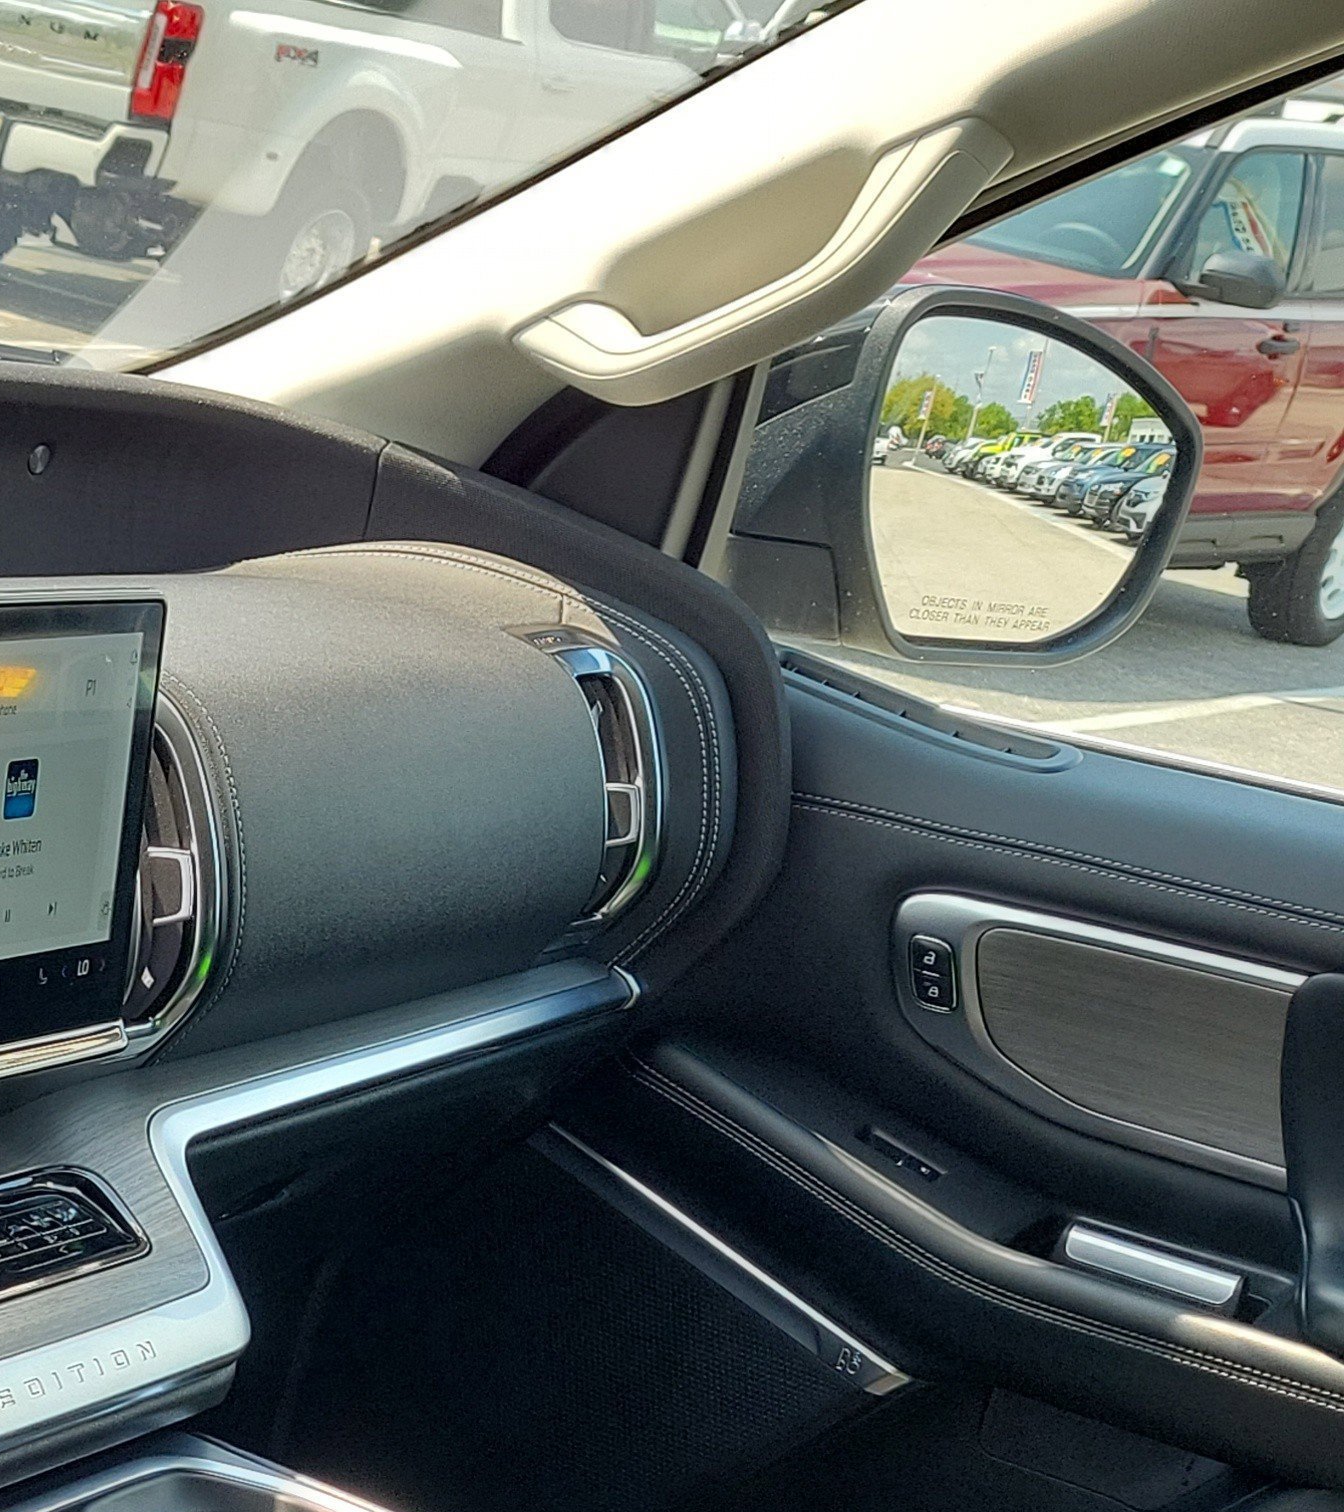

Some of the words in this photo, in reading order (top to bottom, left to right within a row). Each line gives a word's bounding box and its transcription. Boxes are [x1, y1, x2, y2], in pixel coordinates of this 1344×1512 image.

[921, 595, 967, 610] OBJECTS
[971, 601, 983, 611] IN
[987, 603, 1025, 616] MIRROR
[1027, 606, 1049, 618] ARE
[909, 608, 949, 622] CLOSER
[953, 613, 981, 626] THAN
[984, 616, 1009, 628] THEY
[1012, 618, 1051, 632] APPEAR
